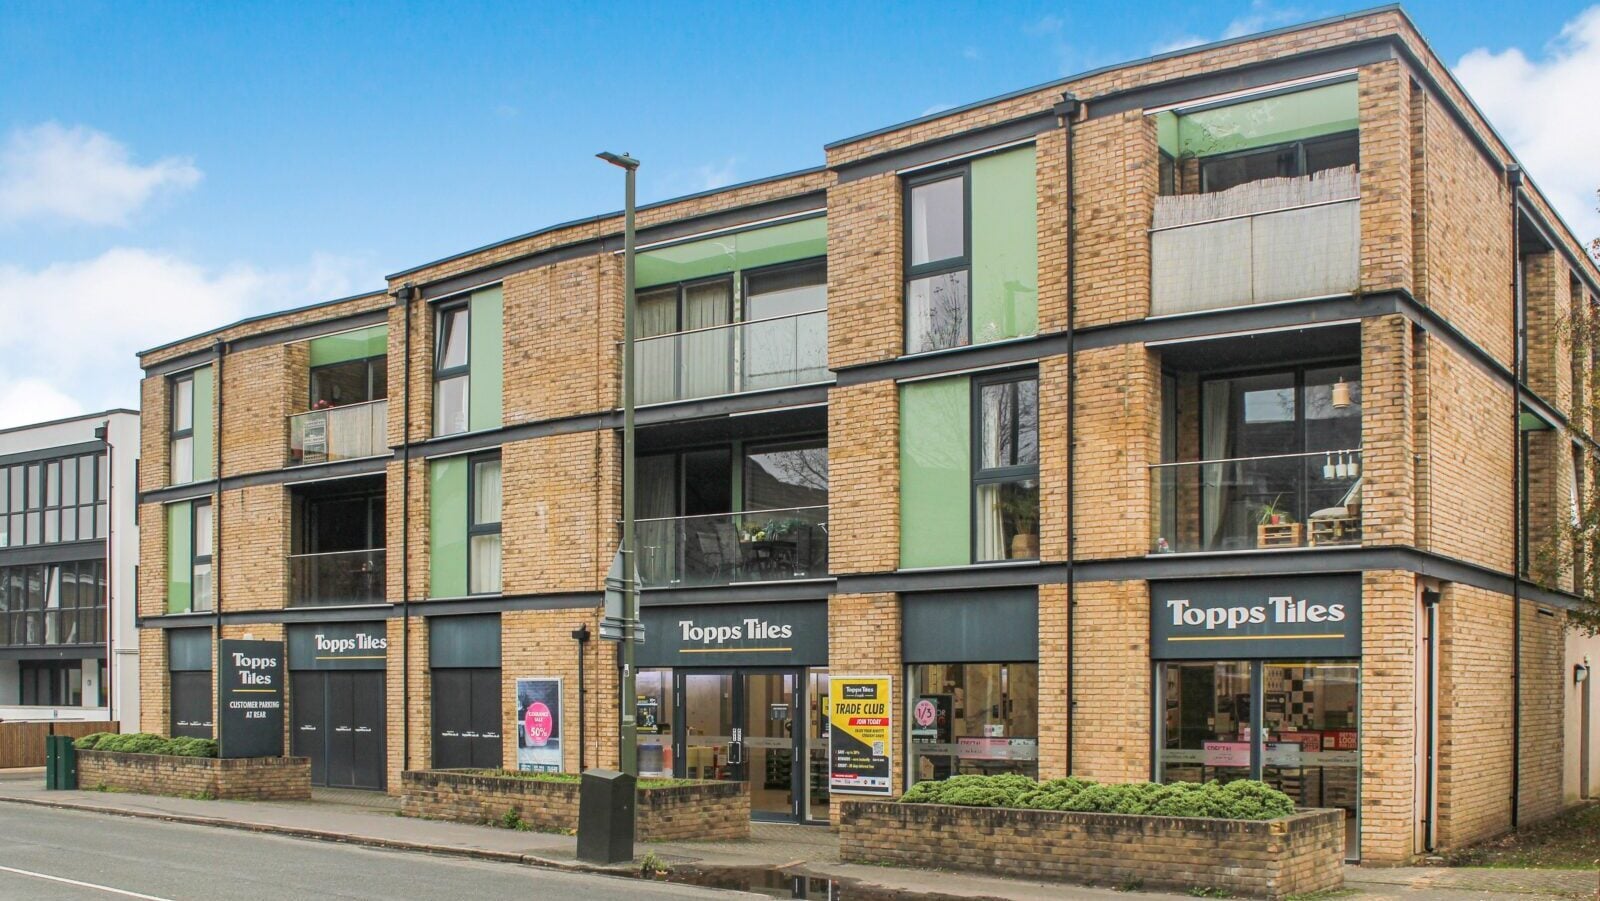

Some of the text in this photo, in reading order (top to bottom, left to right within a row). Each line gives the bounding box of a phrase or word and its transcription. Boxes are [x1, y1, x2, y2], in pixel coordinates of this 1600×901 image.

[1167, 596, 1345, 629] Topps Tiles
[679, 618, 793, 643] Topps Tiles
[315, 633, 387, 652] Topps Tiles
[232, 652, 277, 669] Topps
[239, 670, 272, 685] Tiles
[229, 701, 280, 709] CUSTOMER PARKING
[836, 703, 885, 715] TRADE CLUB
[918, 707, 932, 720] 1/3
[531, 727, 547, 737] 50%
